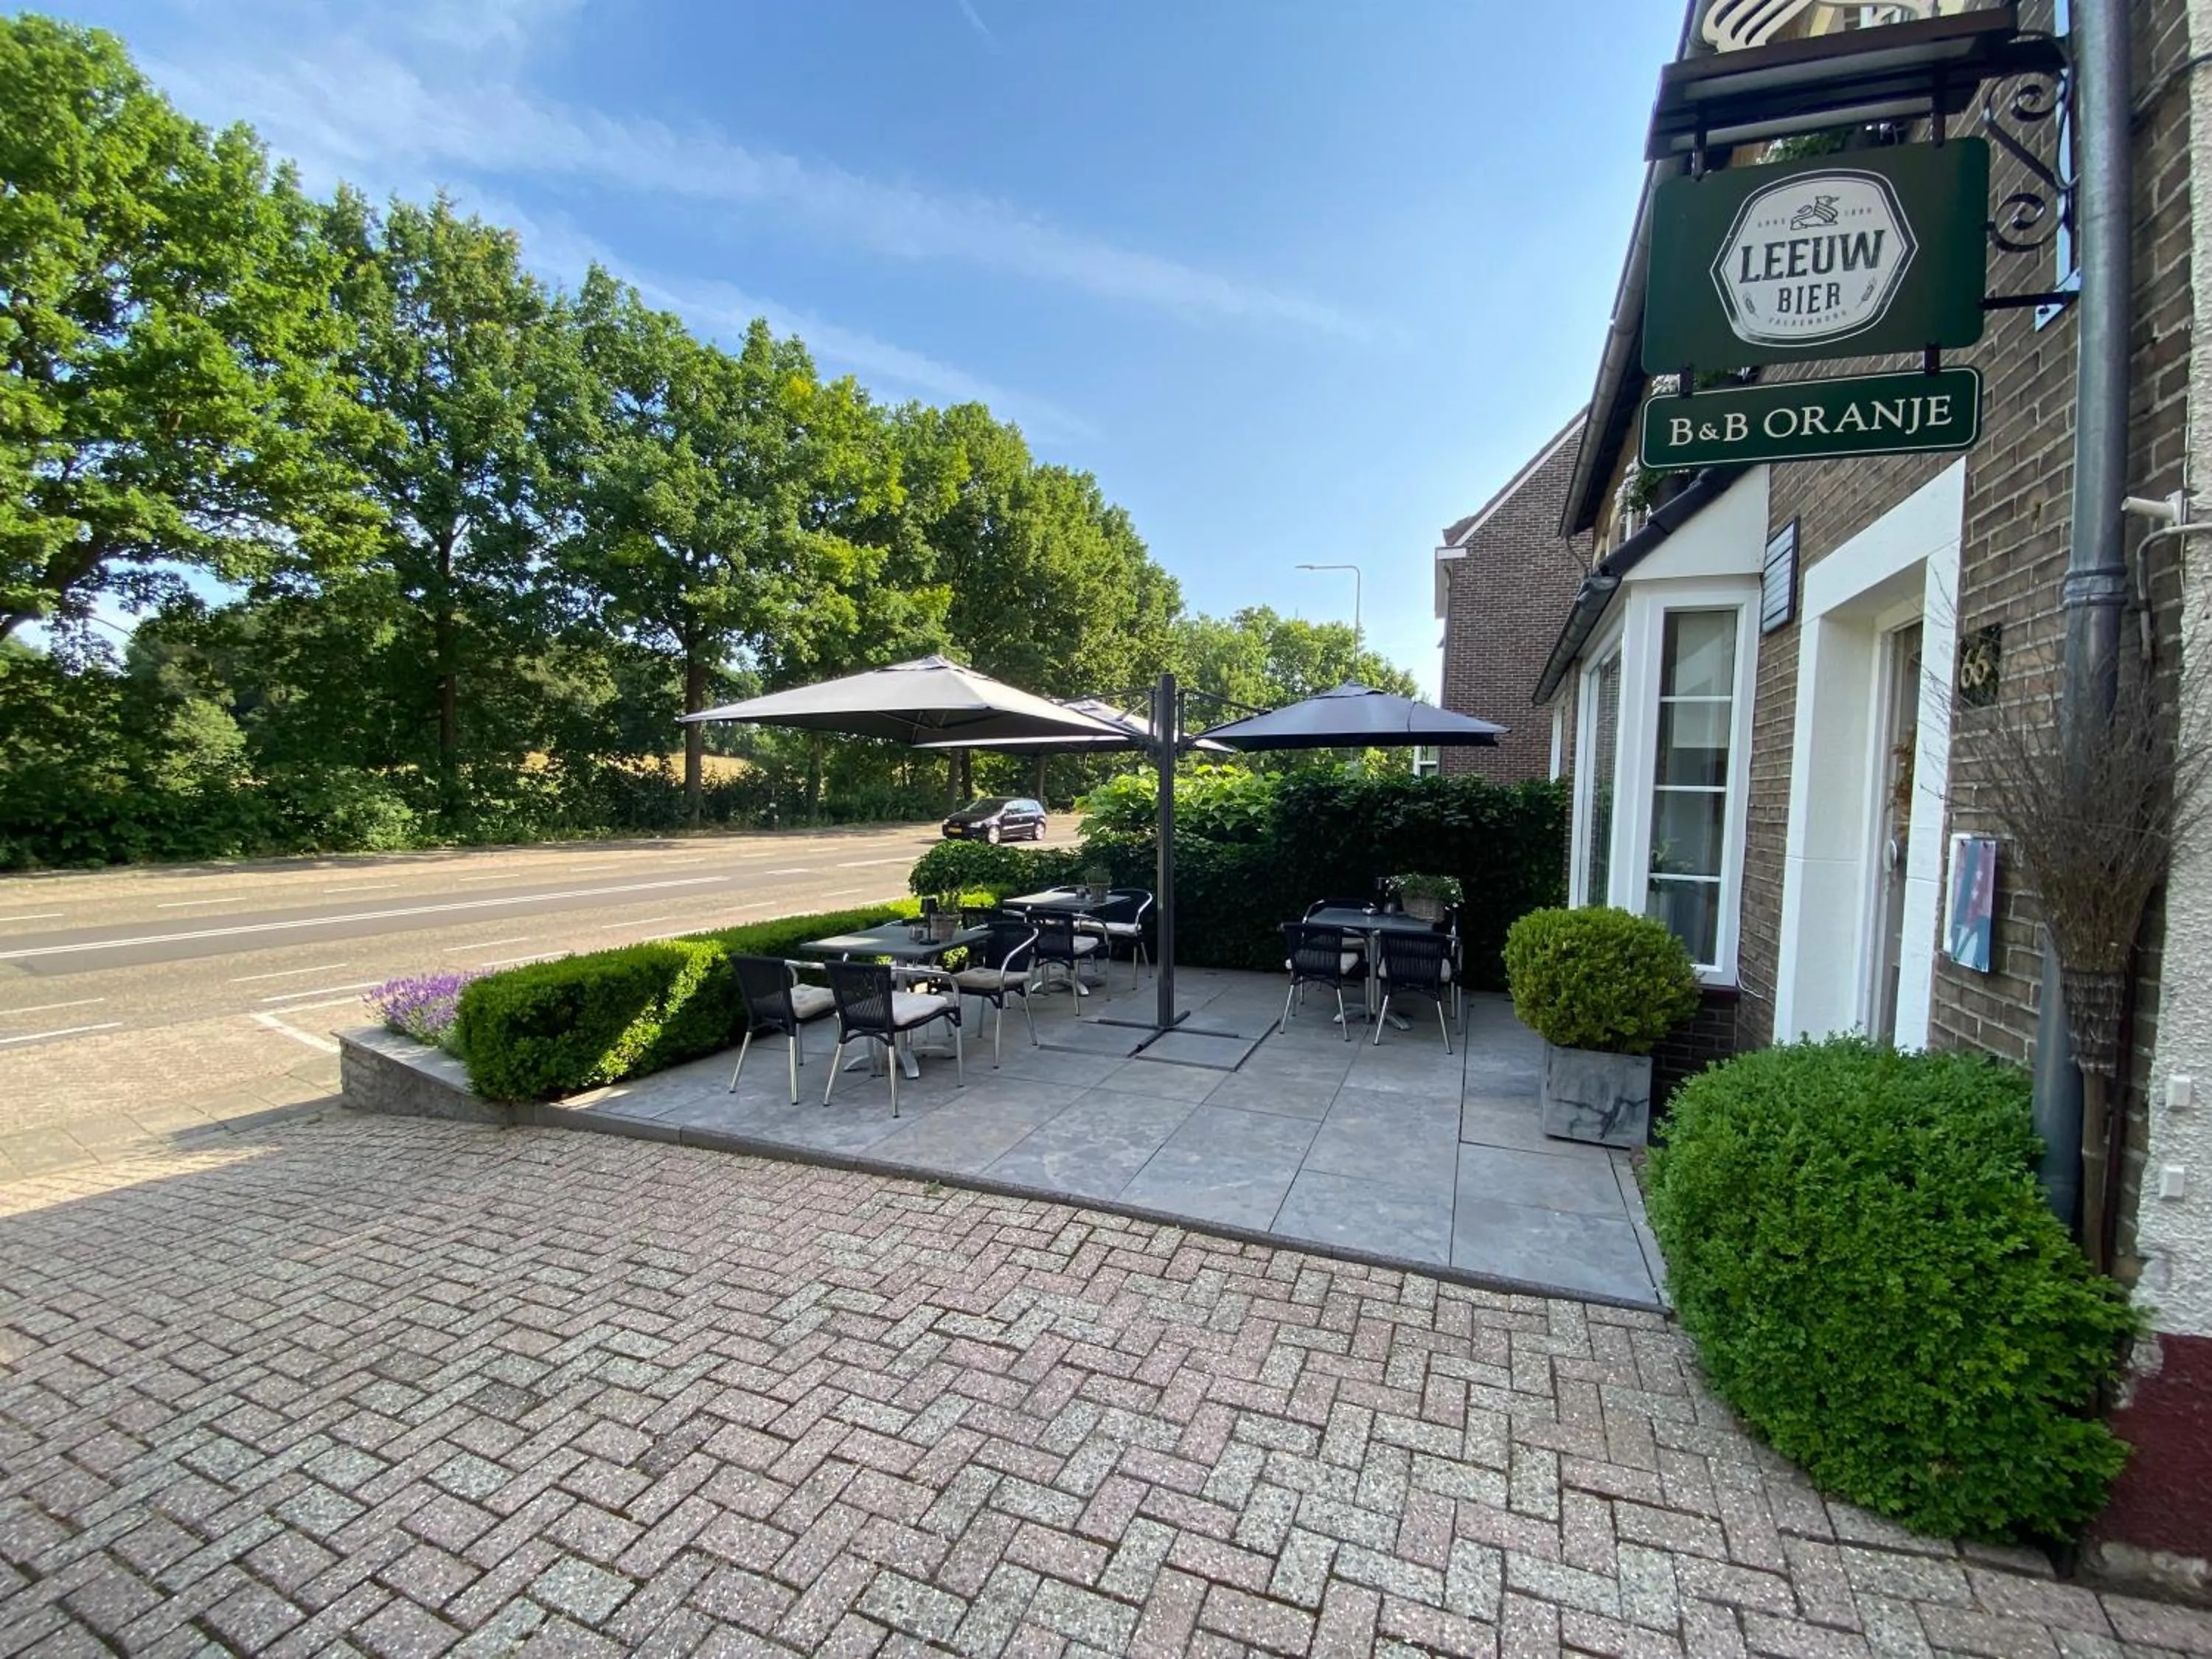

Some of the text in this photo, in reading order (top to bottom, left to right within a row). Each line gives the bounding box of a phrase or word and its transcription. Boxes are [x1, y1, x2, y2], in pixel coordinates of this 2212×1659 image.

[1739, 229, 1885, 283] LEEUW
[1777, 282, 1840, 314] BIER
[1669, 395, 1952, 447] B&B ORANJE
[1961, 645, 1990, 689] 66
